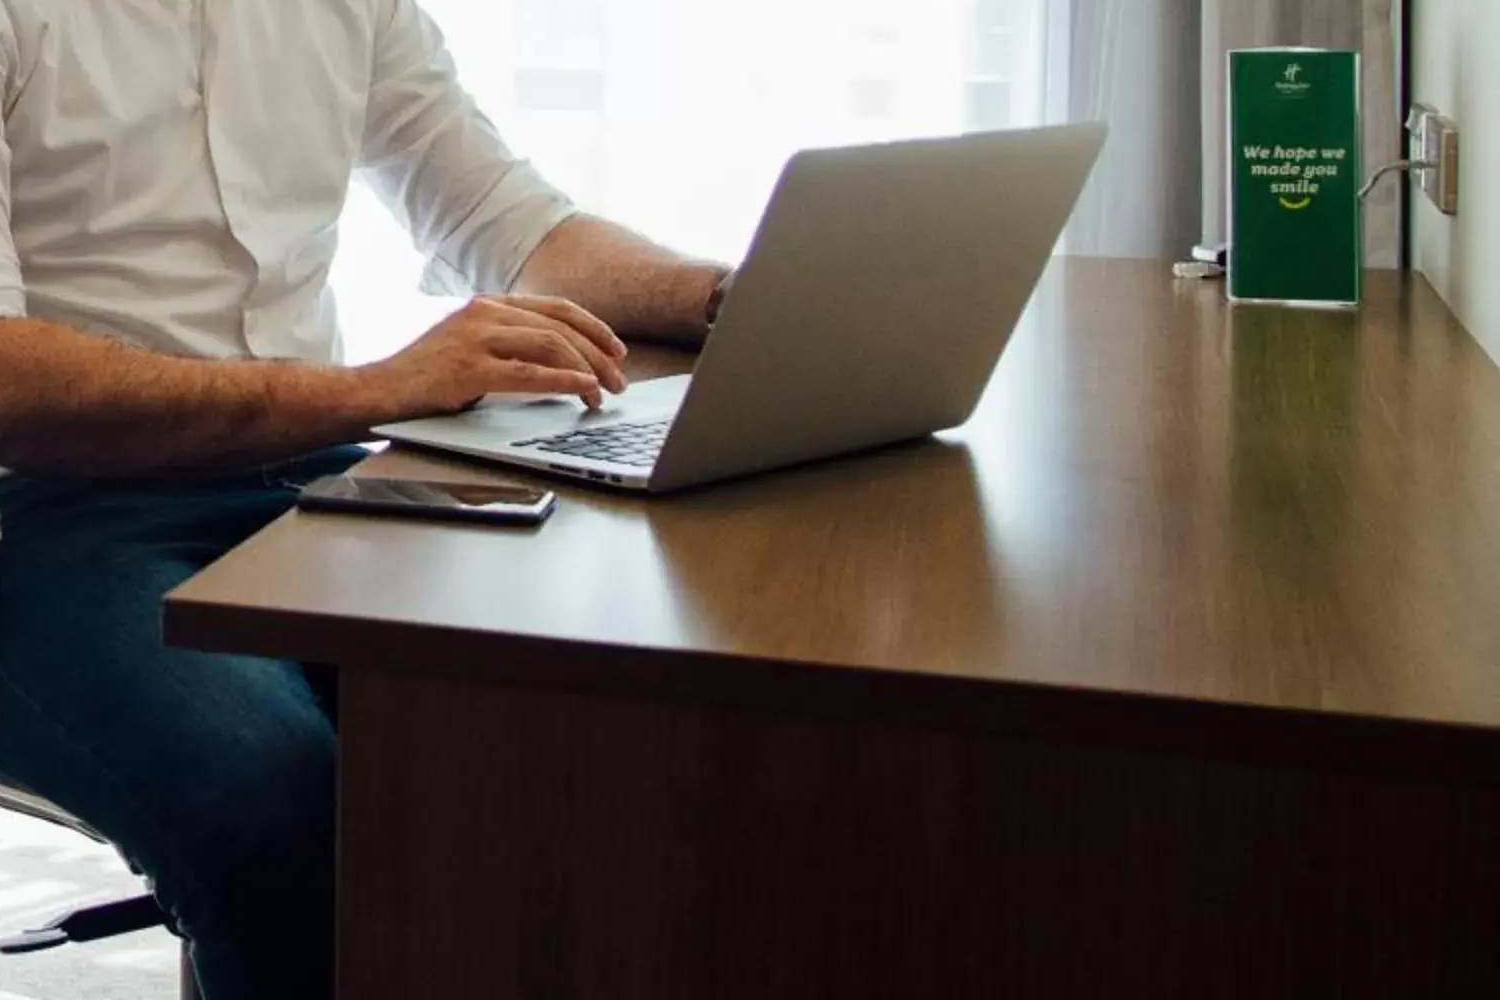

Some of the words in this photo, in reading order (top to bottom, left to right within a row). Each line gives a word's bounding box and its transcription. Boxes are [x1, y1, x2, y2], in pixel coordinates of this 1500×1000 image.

[1243, 145, 1270, 159] We
[1273, 144, 1317, 162] hope
[1320, 148, 1346, 159] we
[1251, 162, 1301, 176] made
[1303, 164, 1338, 179] you
[1270, 179, 1320, 194] smile
